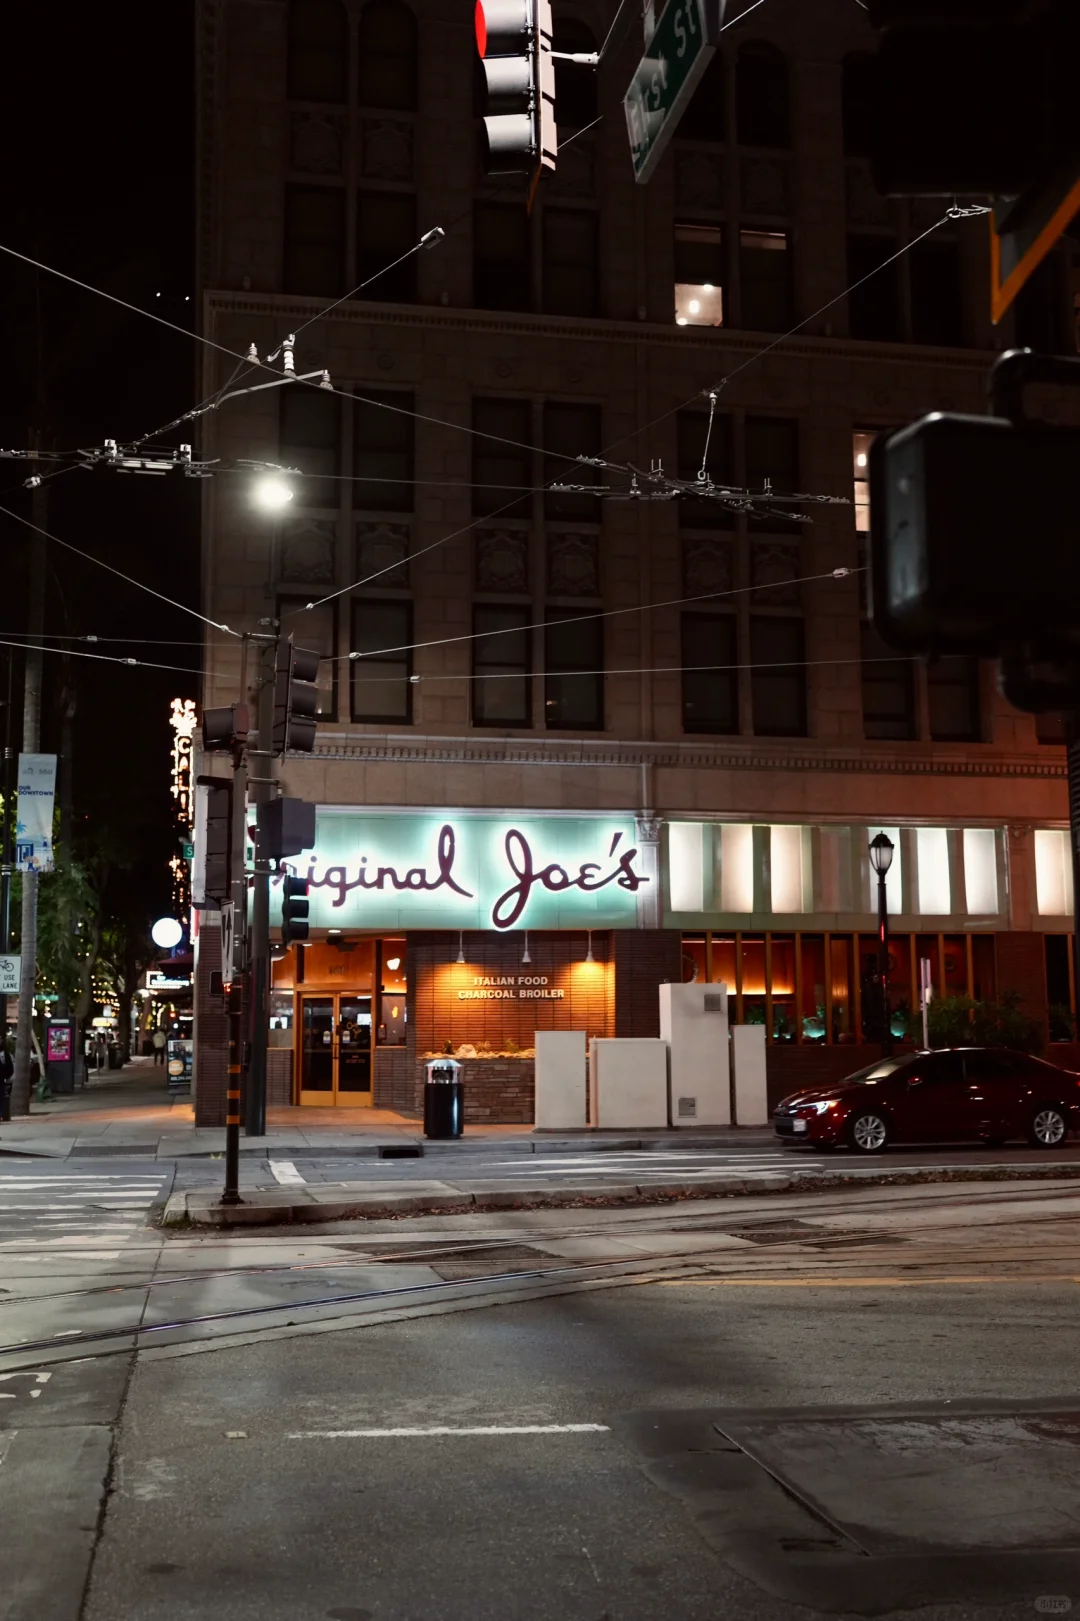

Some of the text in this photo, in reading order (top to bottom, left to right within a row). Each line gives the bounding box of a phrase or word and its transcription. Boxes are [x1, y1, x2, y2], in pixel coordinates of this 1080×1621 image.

[491, 828, 651, 930] Joe's
[473, 976, 548, 986] ITALIAN FOOD
[458, 988, 565, 999] CHARCOAL BROILER
